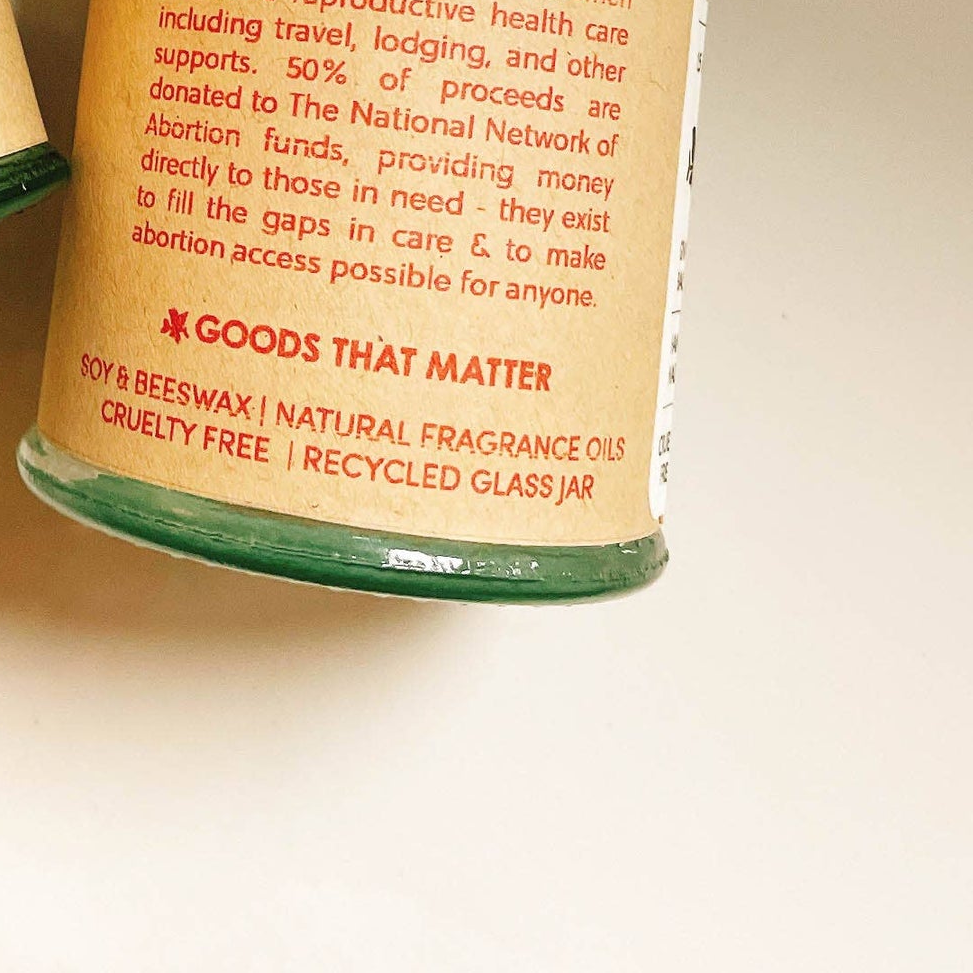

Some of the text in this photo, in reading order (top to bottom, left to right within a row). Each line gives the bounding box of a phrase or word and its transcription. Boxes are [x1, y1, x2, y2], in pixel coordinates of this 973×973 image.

[159, 7, 626, 82] including travel, lodging, and other
[491, 2, 573, 36] health
[585, 23, 628, 45] care
[150, 76, 619, 157] donated to The National Network of
[155, 47, 621, 121] supports. 50% of proceeds are
[141, 148, 219, 187] directly
[228, 162, 253, 187] to
[263, 166, 341, 199] those
[353, 179, 379, 204] in
[391, 190, 464, 215] need
[500, 198, 554, 231] they
[562, 211, 609, 232] exist
[145, 113, 614, 199] Abortion funds, providing money
[132, 221, 597, 308] abortion access possible for anyone.
[137, 186, 606, 270] to fill the gaps in care & to make
[195, 314, 552, 391] GOODS THAT MATTER
[81, 353, 114, 383] SOY
[117, 365, 130, 390] &
[134, 369, 252, 419] BEESWAX
[276, 401, 410, 446] NATURAL
[421, 423, 580, 461] FRAGRANCE
[586, 437, 625, 461] OILS
[101, 399, 198, 445] CRUELTY
[203, 425, 270, 463] FREE
[303, 445, 460, 491] RECYCLED
[471, 469, 553, 498] GLASS
[556, 475, 594, 505] JAR
